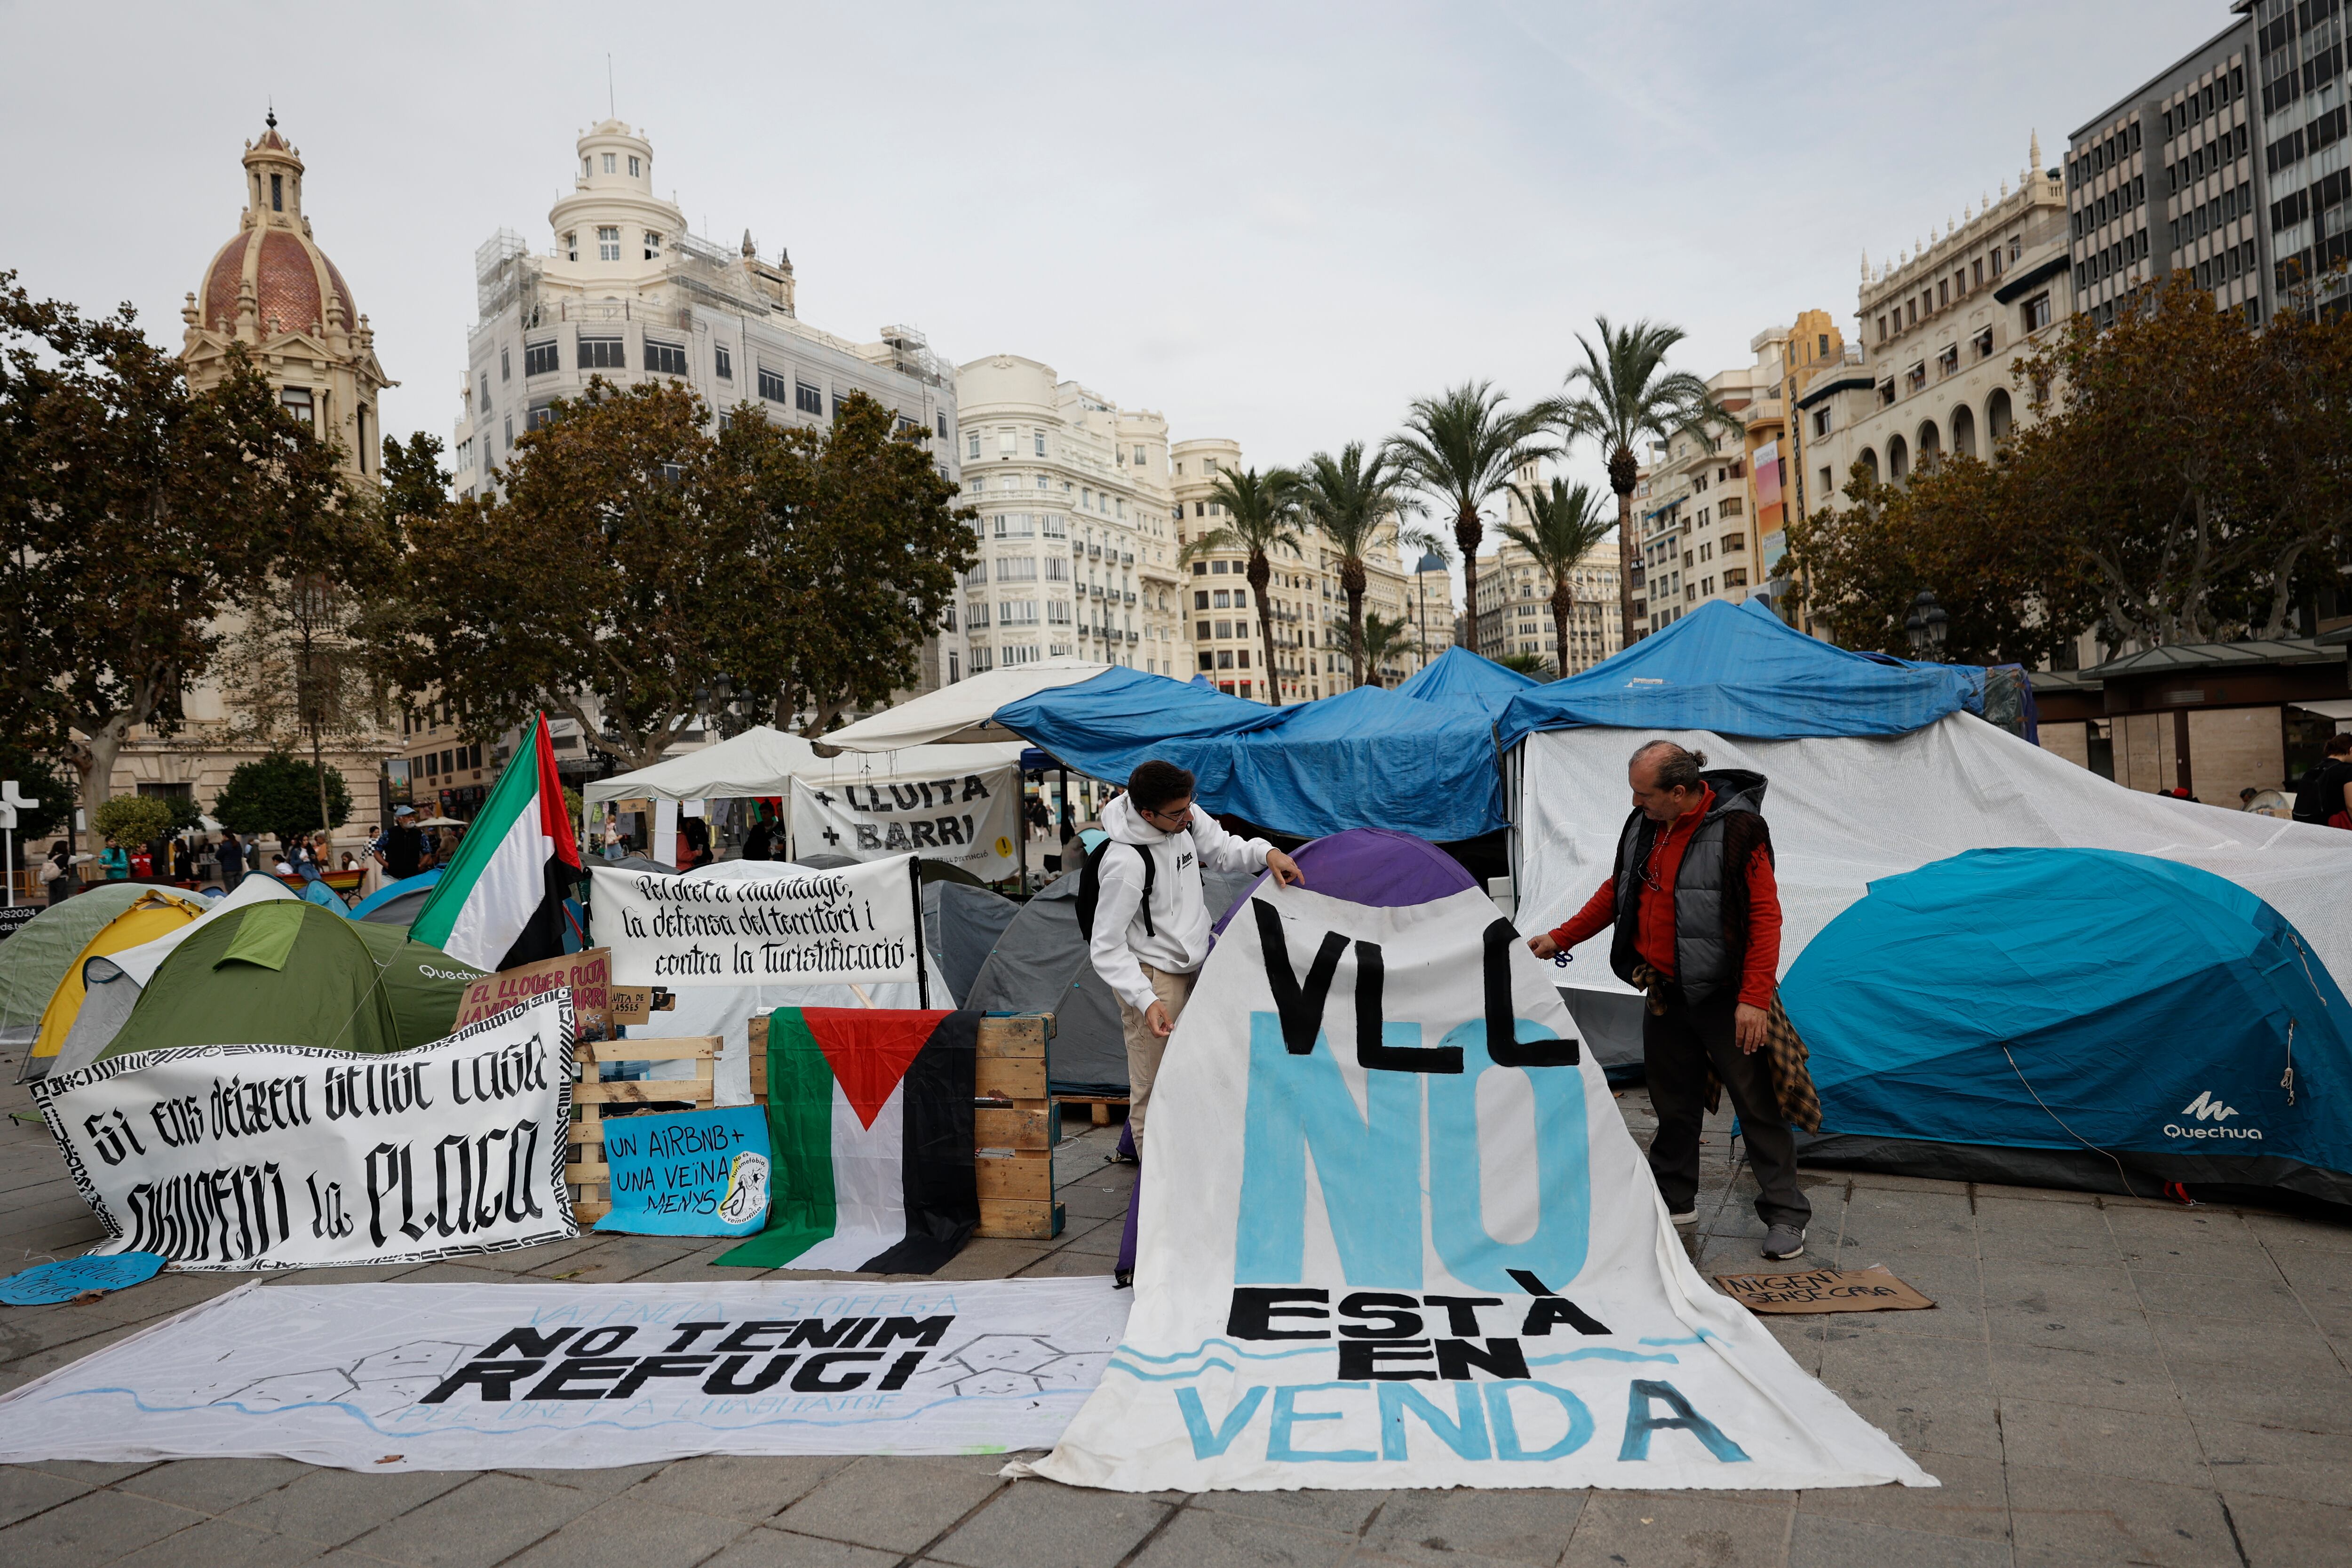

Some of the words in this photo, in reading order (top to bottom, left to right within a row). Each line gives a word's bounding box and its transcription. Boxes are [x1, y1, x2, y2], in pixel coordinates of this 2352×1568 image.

[846, 775, 990, 812] LLUITA
[853, 814, 974, 851] BARRI
[631, 876, 672, 901] Pel
[671, 876, 720, 903] dret
[622, 906, 648, 938] la
[652, 904, 737, 938] defensa
[739, 905, 772, 936] del
[865, 899, 876, 931] i
[419, 964, 488, 980] Quechu
[654, 941, 723, 976] contra
[732, 940, 755, 975] la
[461, 1006, 481, 1026] LA
[572, 983, 607, 1011] ARRI
[470, 984, 490, 1004] EL
[497, 970, 564, 998] LLOGUER
[612, 993, 631, 1003] UITA
[612, 1003, 639, 1011] ASSES
[82, 1106, 147, 1166] Si
[149, 1096, 205, 1148] ens
[210, 1072, 311, 1141] deixen
[452, 1032, 548, 1105] casa
[610, 1133, 637, 1158] UN
[2163, 1124, 2262, 1140] Quechua
[1233, 1011, 1592, 1294] NO
[617, 1166, 656, 1192] UNA
[306, 1170, 354, 1240] la
[643, 1189, 717, 1215] MENYS
[1226, 1268, 1613, 1340] ESTÀ
[1747, 1287, 1832, 1304] SENSE
[1829, 1286, 1898, 1299] CASA
[472, 1326, 638, 1359] NO
[661, 1315, 956, 1353] TENIM
[1338, 1337, 1531, 1380] EN
[419, 1351, 928, 1404] REFUGI
[1173, 1379, 1752, 1462] VENDA
